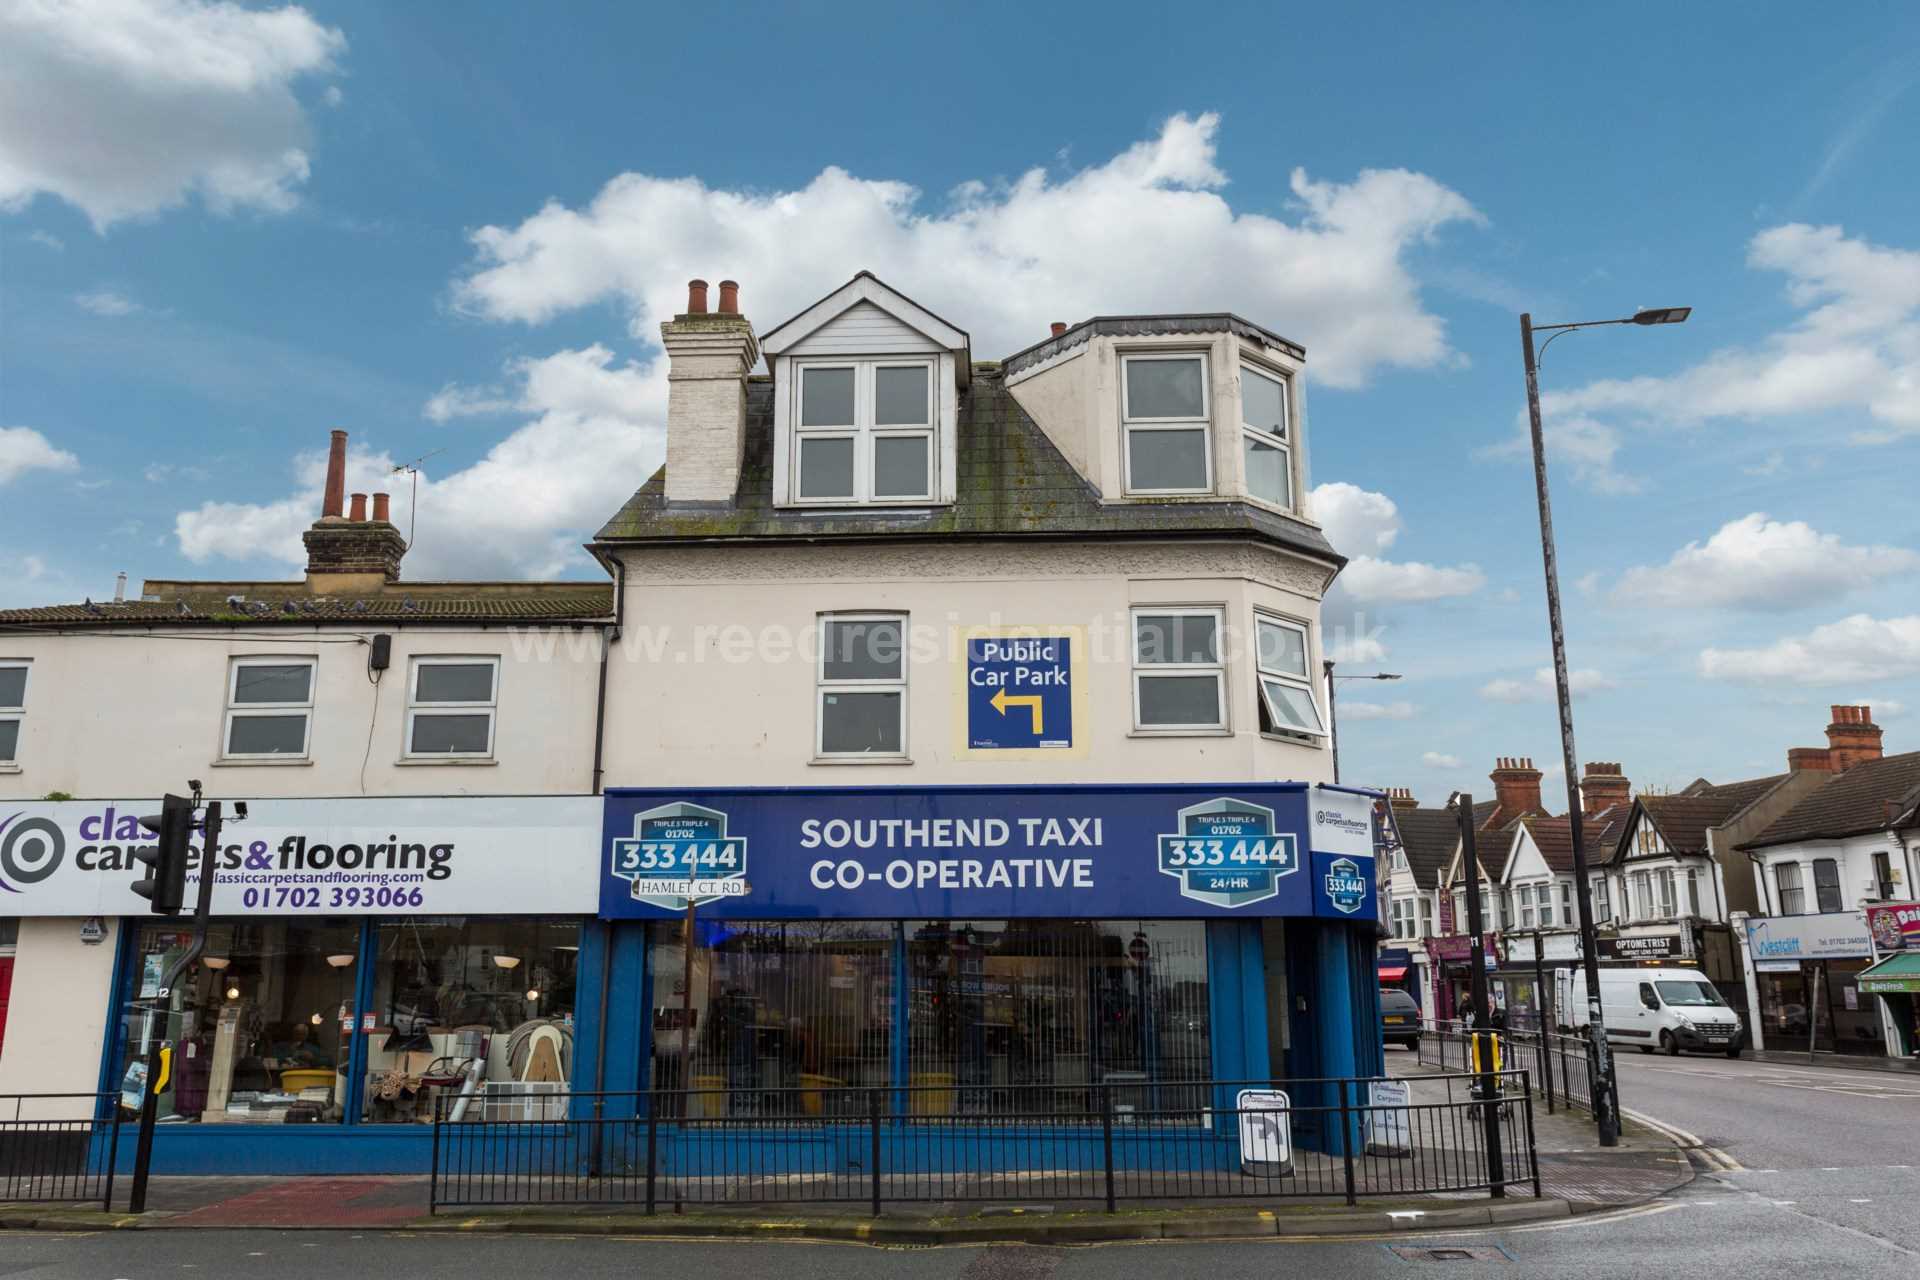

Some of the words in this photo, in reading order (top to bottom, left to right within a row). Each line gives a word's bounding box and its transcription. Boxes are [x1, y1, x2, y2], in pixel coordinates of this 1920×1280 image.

[983, 641, 1053, 662] Public
[970, 667, 1009, 686] Car
[1015, 665, 1067, 685] Park
[665, 829, 695, 838] 01702
[800, 818, 1009, 848] SOUTHEND
[1018, 818, 1103, 846] TAXI
[1211, 825, 1242, 835] 01702
[622, 844, 676, 869] 333
[681, 843, 737, 868] 444
[1169, 840, 1224, 865] 333
[1230, 840, 1287, 864] 444
[810, 858, 1094, 889] CO-OPERATIVE
[641, 882, 691, 894] HAMLET
[1328, 879, 1345, 892] 333
[1346, 880, 1362, 892] 444
[243, 887, 320, 908] 01702
[329, 886, 424, 908] 393066
[1616, 938, 1671, 949] OPTOMETRIST
